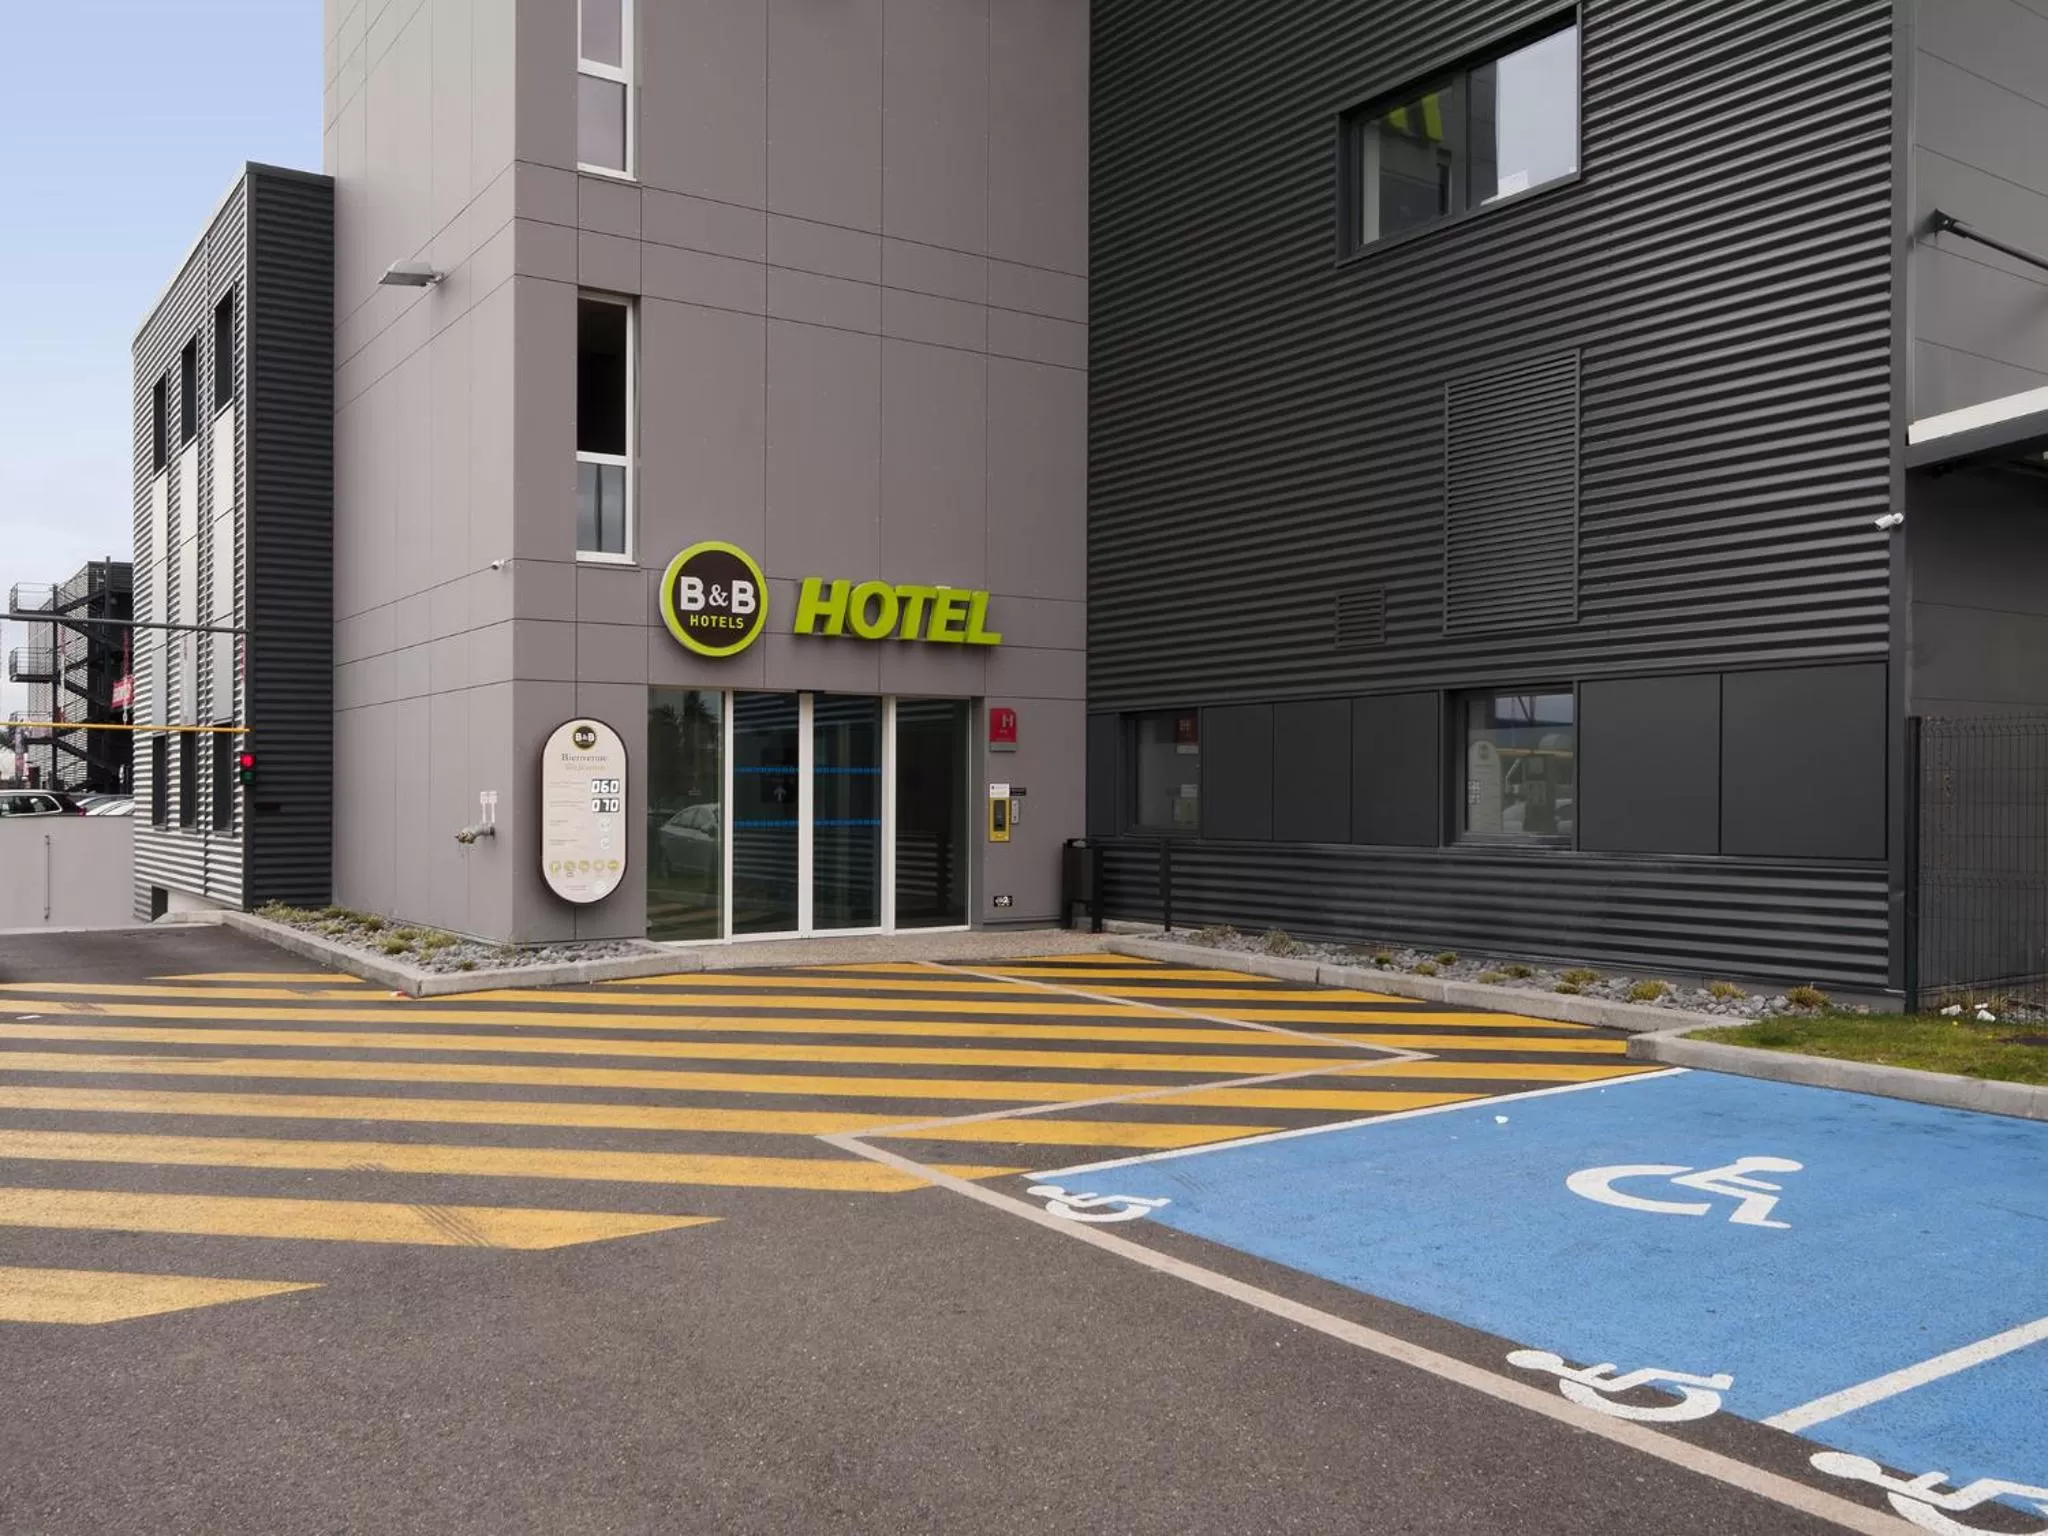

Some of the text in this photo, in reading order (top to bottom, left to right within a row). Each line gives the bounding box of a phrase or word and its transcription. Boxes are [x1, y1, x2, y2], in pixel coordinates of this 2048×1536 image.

[680, 576, 756, 614] B&B
[794, 577, 1003, 645] HOTEL
[690, 614, 744, 629] HOTELS
[591, 780, 619, 793] 060
[591, 799, 619, 812] 070
